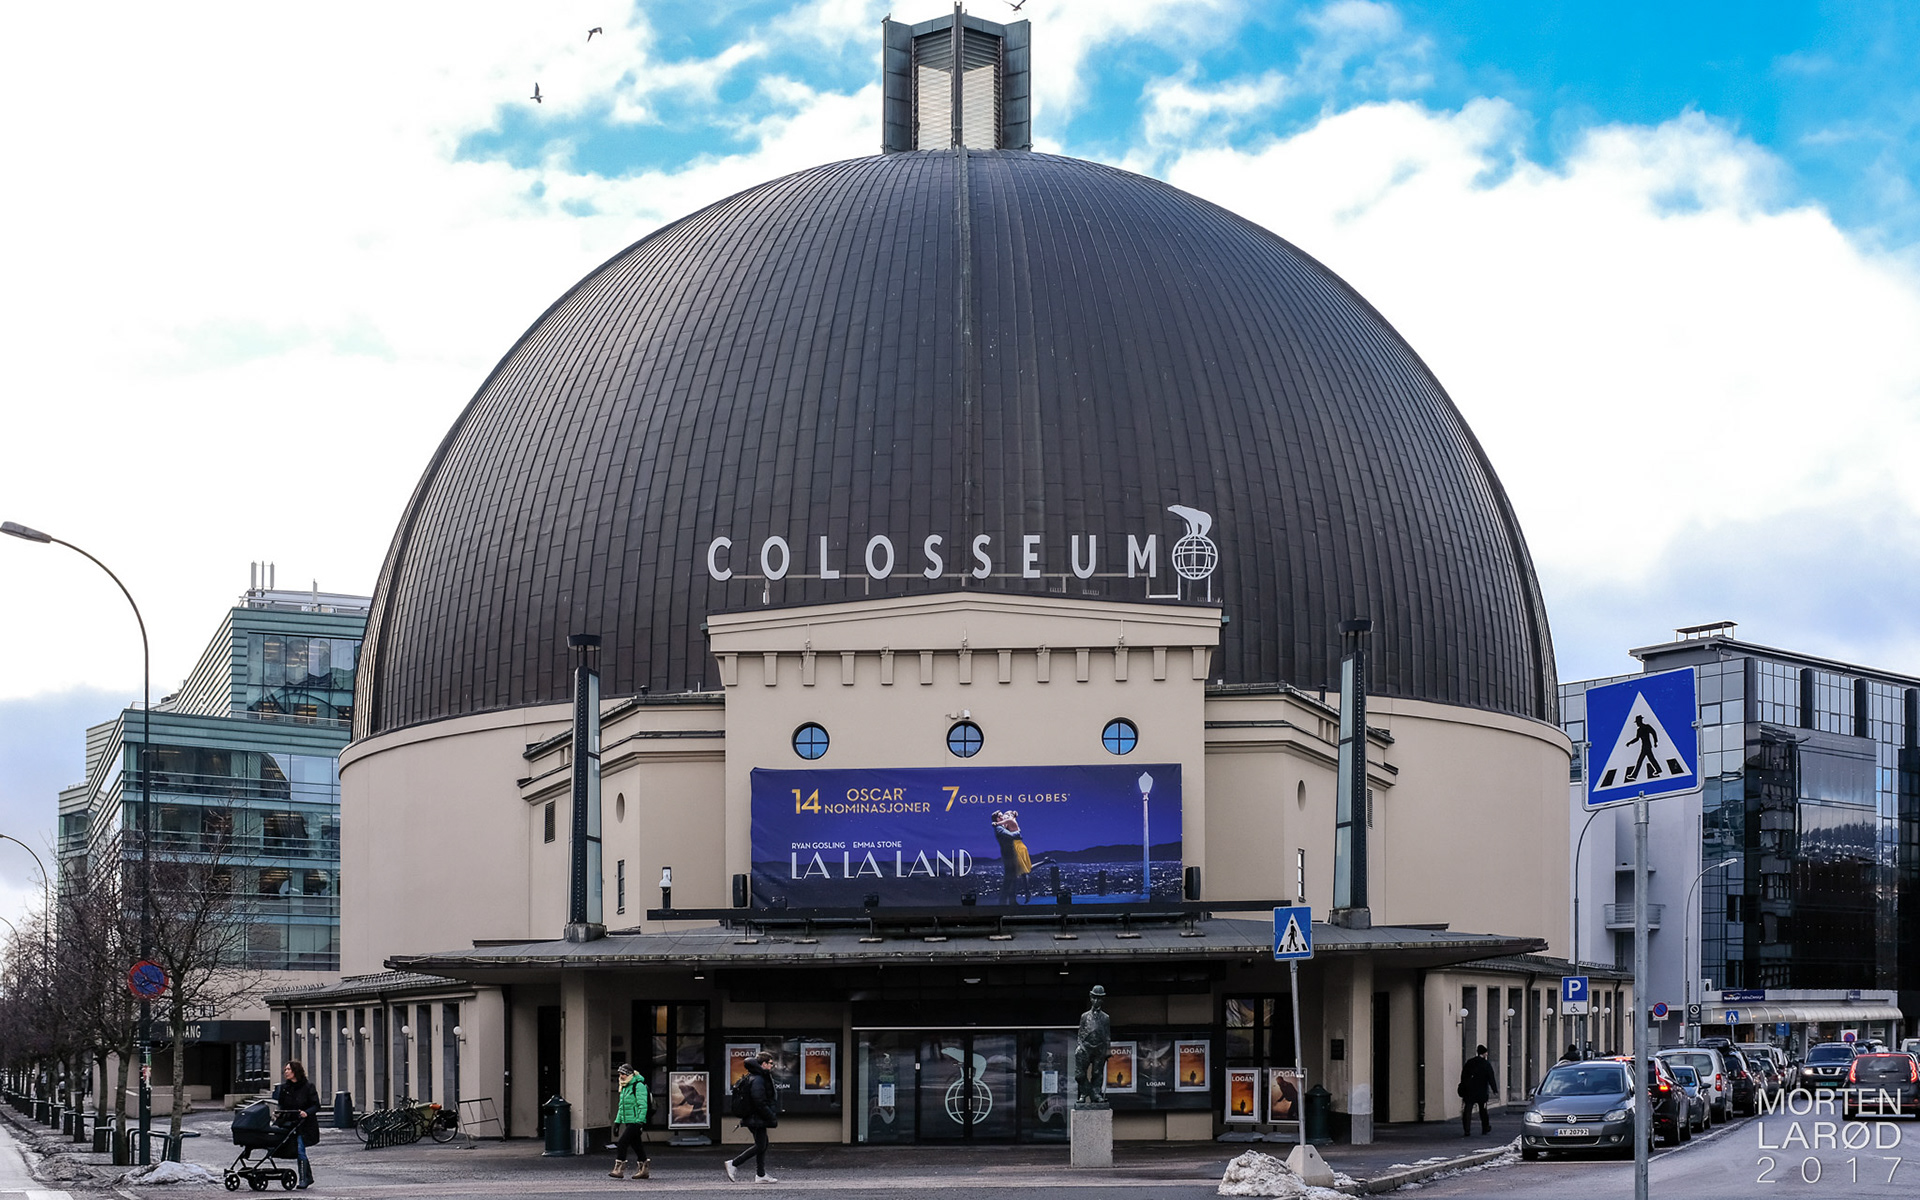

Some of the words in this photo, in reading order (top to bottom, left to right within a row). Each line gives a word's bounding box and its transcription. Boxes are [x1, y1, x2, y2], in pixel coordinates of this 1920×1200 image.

[707, 534, 1157, 581] COLOSSEUM
[791, 788, 821, 814] 14
[824, 802, 931, 814] NOMINASJONER
[942, 786, 960, 812] 7
[959, 794, 1013, 804] GOLDEN
[791, 842, 811, 850] RYAN
[812, 841, 846, 850] GOSLING
[853, 841, 876, 849] EMMA
[877, 840, 902, 848] STONE
[791, 851, 831, 880] LA
[844, 850, 883, 879] LA
[896, 849, 973, 878] LAND
[1568, 979, 1582, 999] P
[675, 1074, 704, 1082] LOGAN
